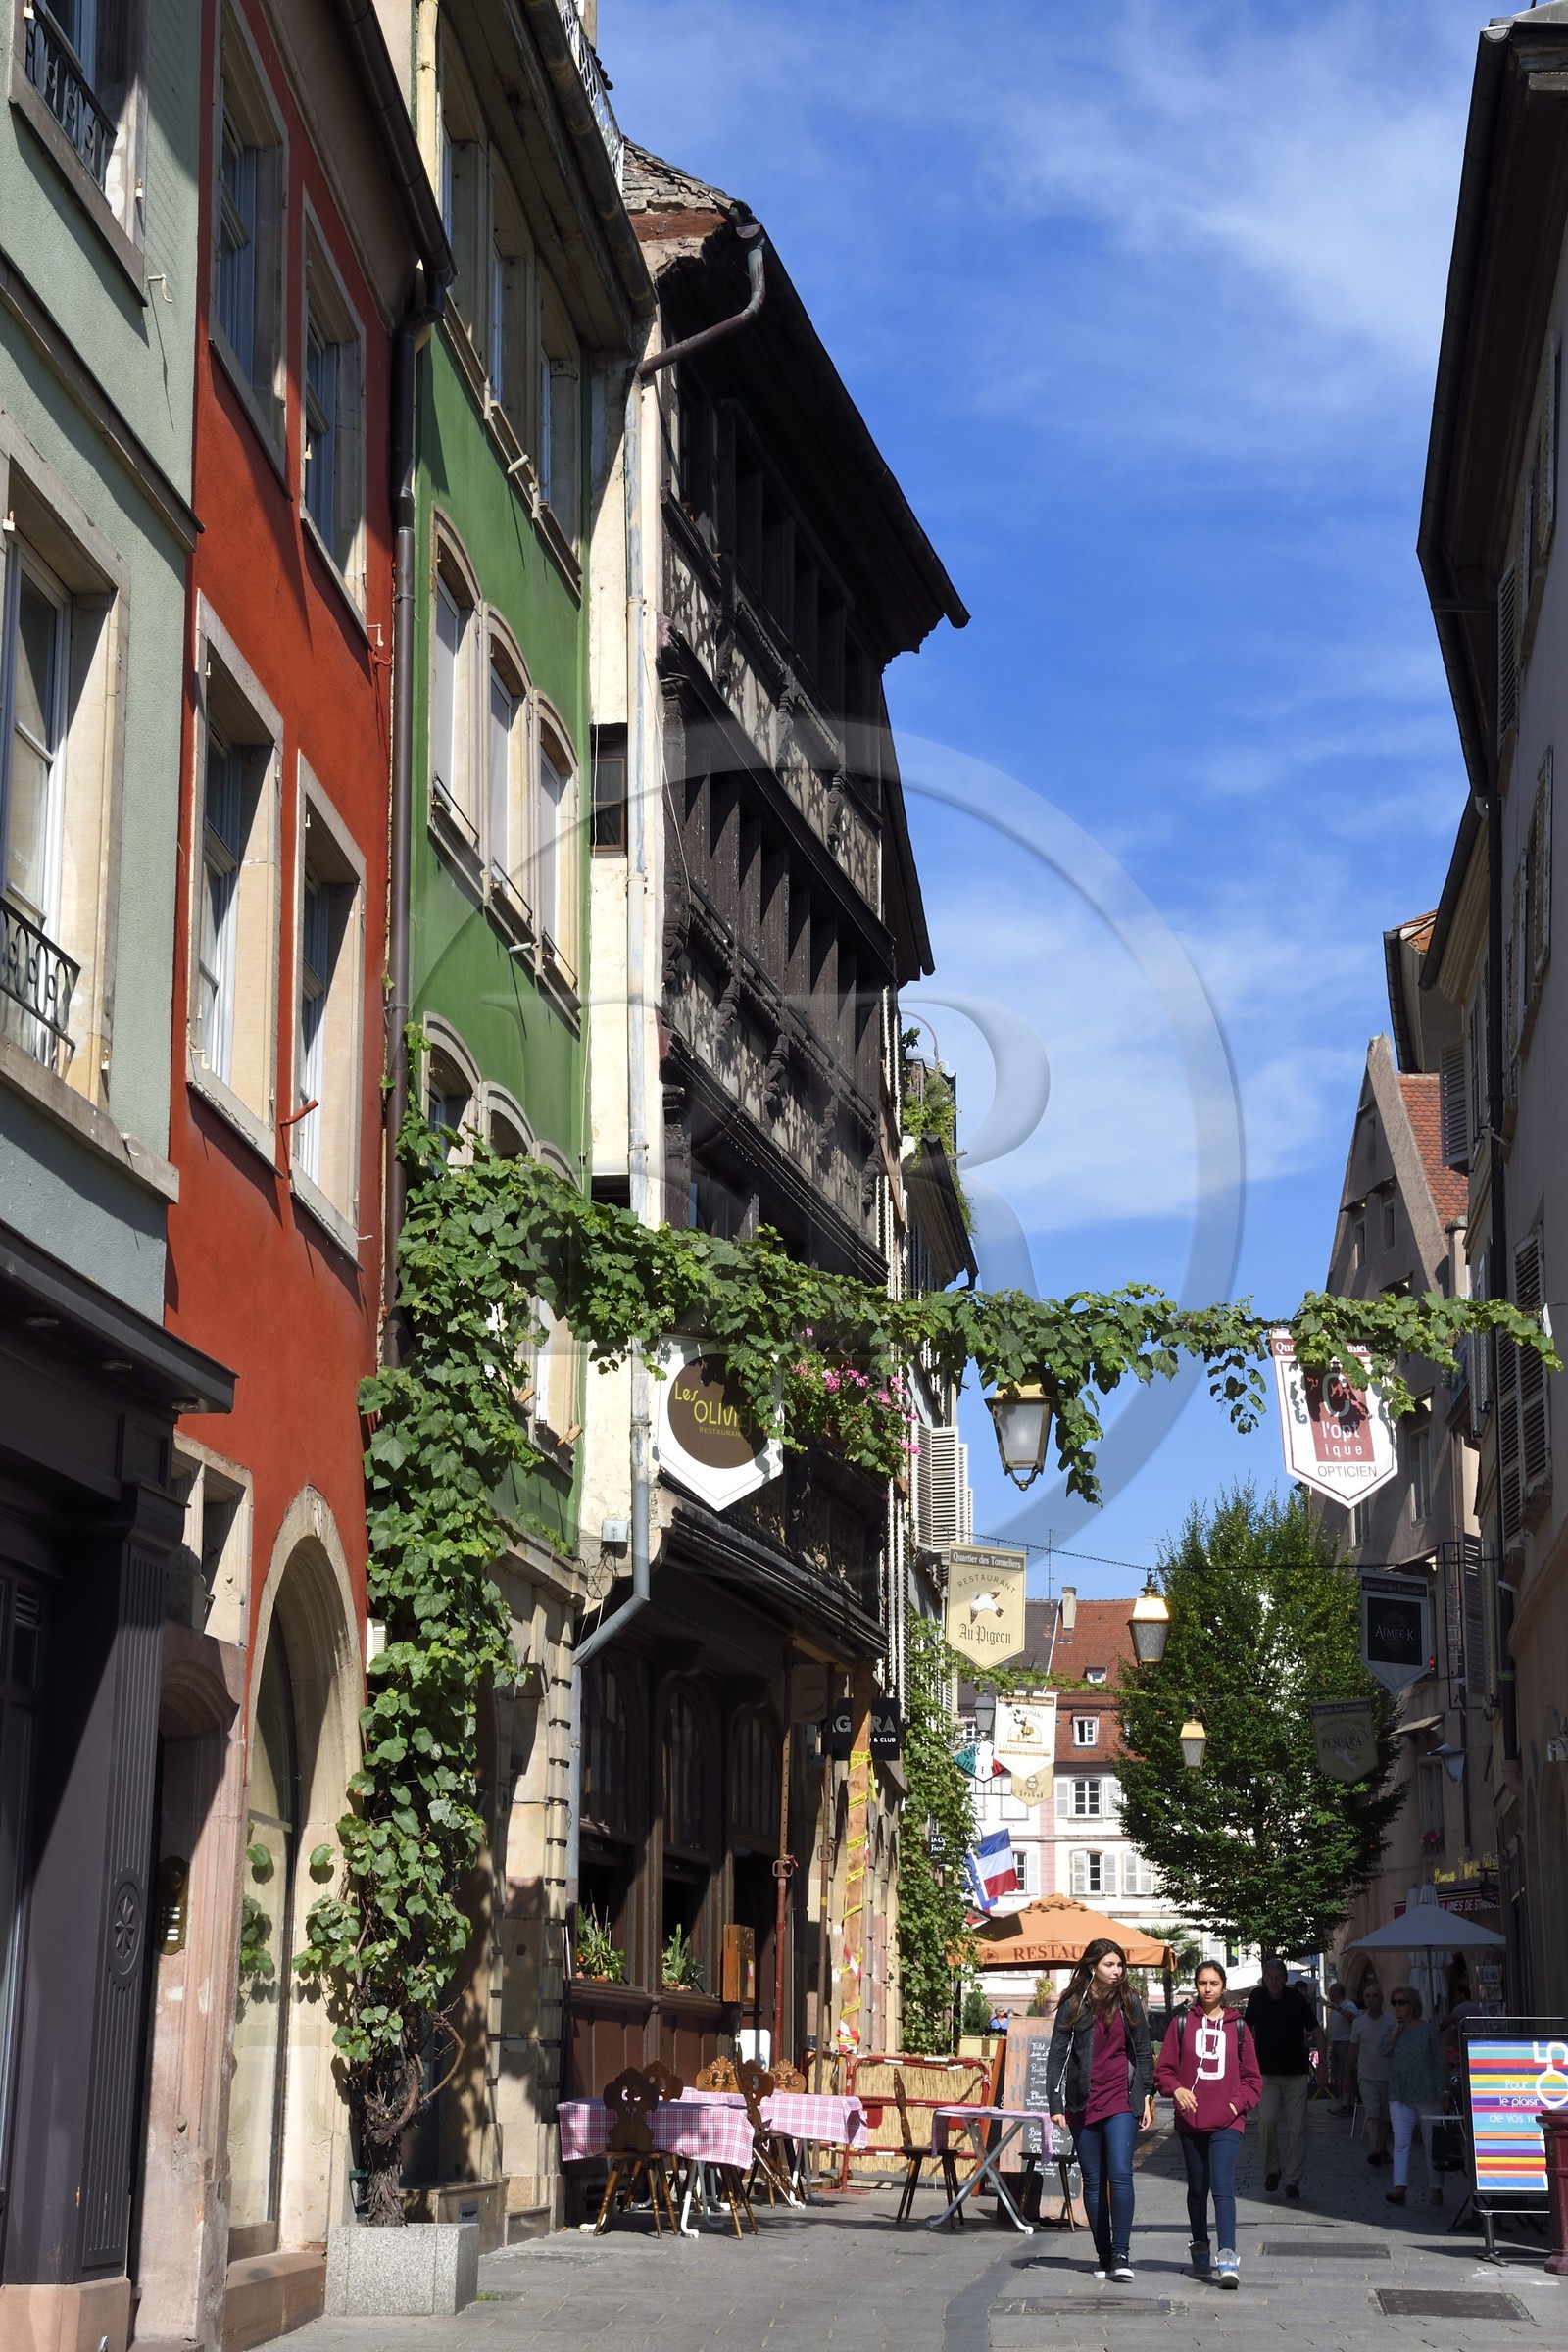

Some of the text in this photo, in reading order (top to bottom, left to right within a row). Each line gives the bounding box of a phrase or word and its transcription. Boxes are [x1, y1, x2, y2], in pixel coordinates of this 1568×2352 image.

[674, 1380, 699, 1402] Les
[1324, 1444, 1363, 1458] ique
[1317, 1465, 1378, 1478] OPTICIEN
[952, 1551, 1021, 1568] Quartier des Tonneliers
[957, 1574, 1015, 1593] RESTAURANT
[959, 1623, 1011, 1645] Au Pigeon
[1012, 1944, 1135, 1961] RESTAUT
[1504, 2078, 1528, 2090] Pour
[1499, 2095, 1541, 2108] le plaisir
[1489, 2112, 1504, 2124] de
